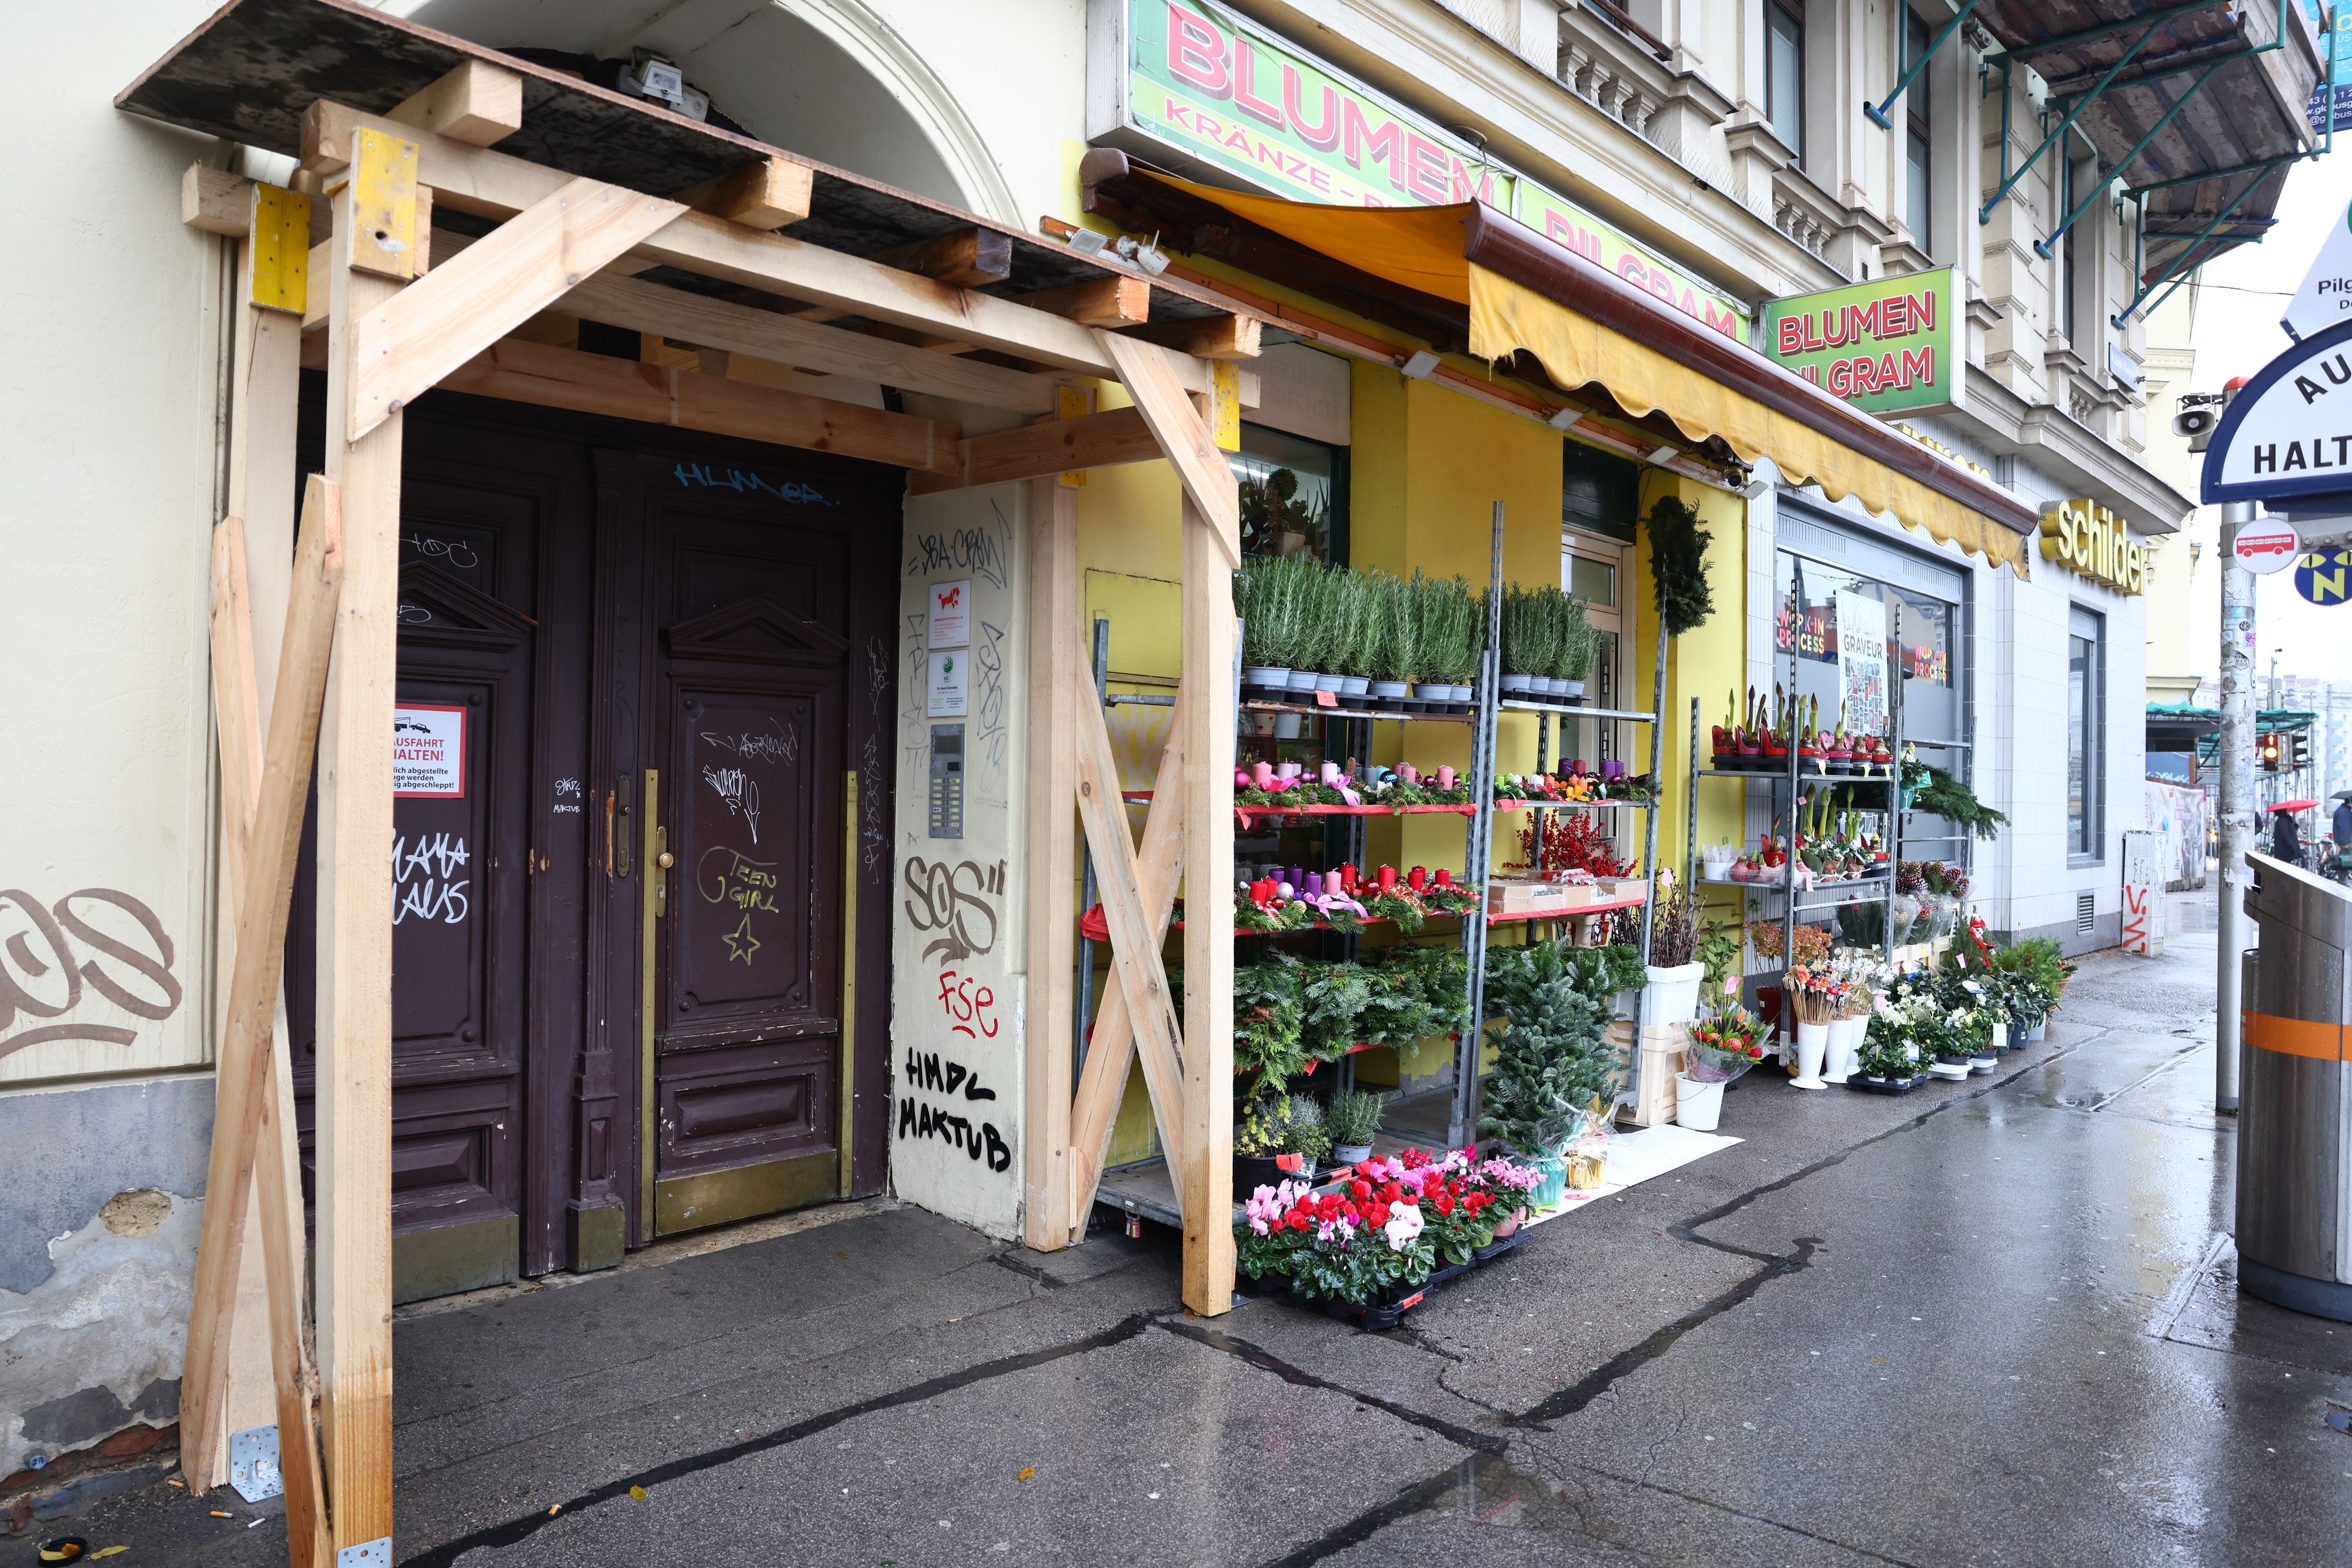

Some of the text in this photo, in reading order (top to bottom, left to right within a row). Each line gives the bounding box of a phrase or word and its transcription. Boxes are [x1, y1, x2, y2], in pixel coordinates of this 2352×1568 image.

[1167, 0, 1495, 207] BLUMEN
[1165, 98, 1331, 195] KRÄNZE
[2340, 299, 2352, 310] D
[1778, 289, 1936, 357] BLUMEN
[1789, 345, 1935, 400] GRAM
[2039, 499, 2147, 596] schilder
[2313, 569, 2344, 601] N
[1814, 617, 1824, 636] IN
[1844, 634, 1883, 660] GRAVEUR
[1915, 661, 1947, 681] PROCESS
[403, 781, 454, 789] abgeschleppt!
[729, 887, 779, 913] GIRL
[899, 1096, 1011, 1172] MAKTUB
